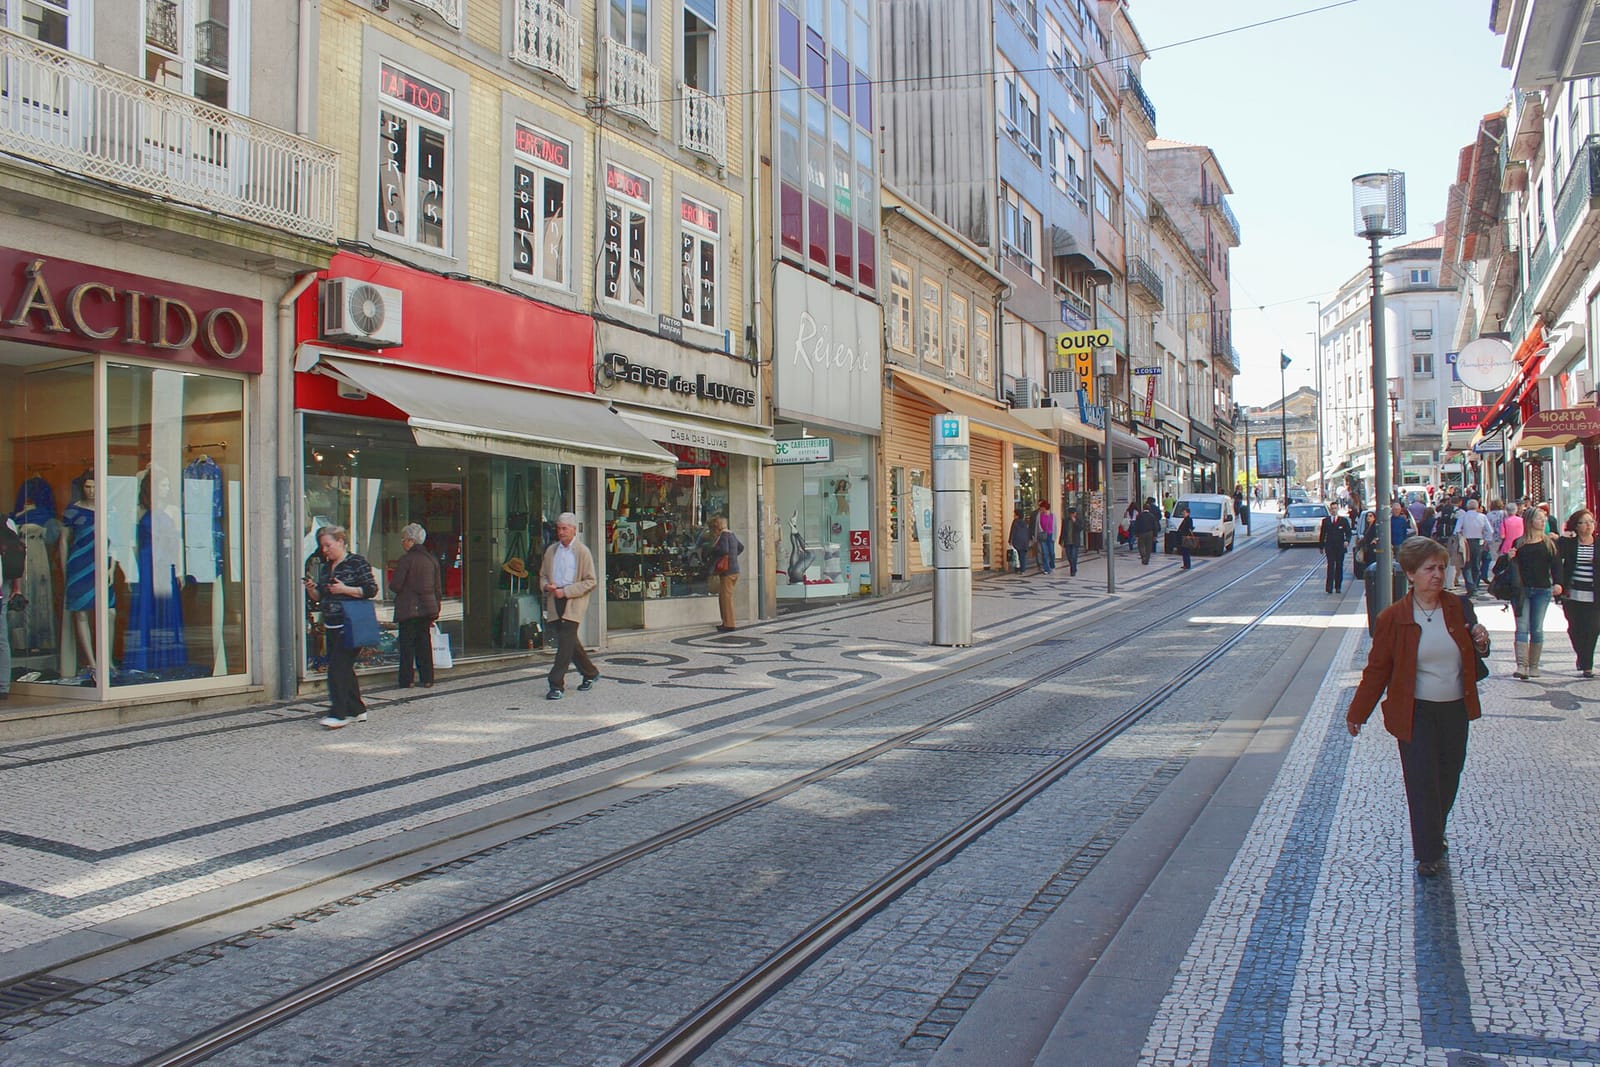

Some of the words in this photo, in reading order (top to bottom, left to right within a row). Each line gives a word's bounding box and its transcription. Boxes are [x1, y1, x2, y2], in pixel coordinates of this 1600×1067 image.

[381, 69, 442, 114] TATTOO
[387, 121, 400, 223] PORTO
[607, 169, 642, 199] ATTOO
[520, 173, 531, 264] PORTO
[609, 210, 619, 293] PORTO
[683, 237, 692, 313] PORTO
[0, 258, 249, 359] ÁCIDO
[1061, 334, 1109, 349] OURO
[606, 353, 669, 388] Casa
[671, 375, 697, 394] das
[698, 374, 757, 405] Luvas
[1078, 353, 1089, 392] OUR
[1539, 411, 1586, 422] HORTA
[1551, 423, 1600, 431] OCULISTA
[671, 430, 690, 441] CASA
[692, 435, 705, 444] DAS
[707, 436, 728, 448] LUVAS
[853, 532, 868, 546] 5€
